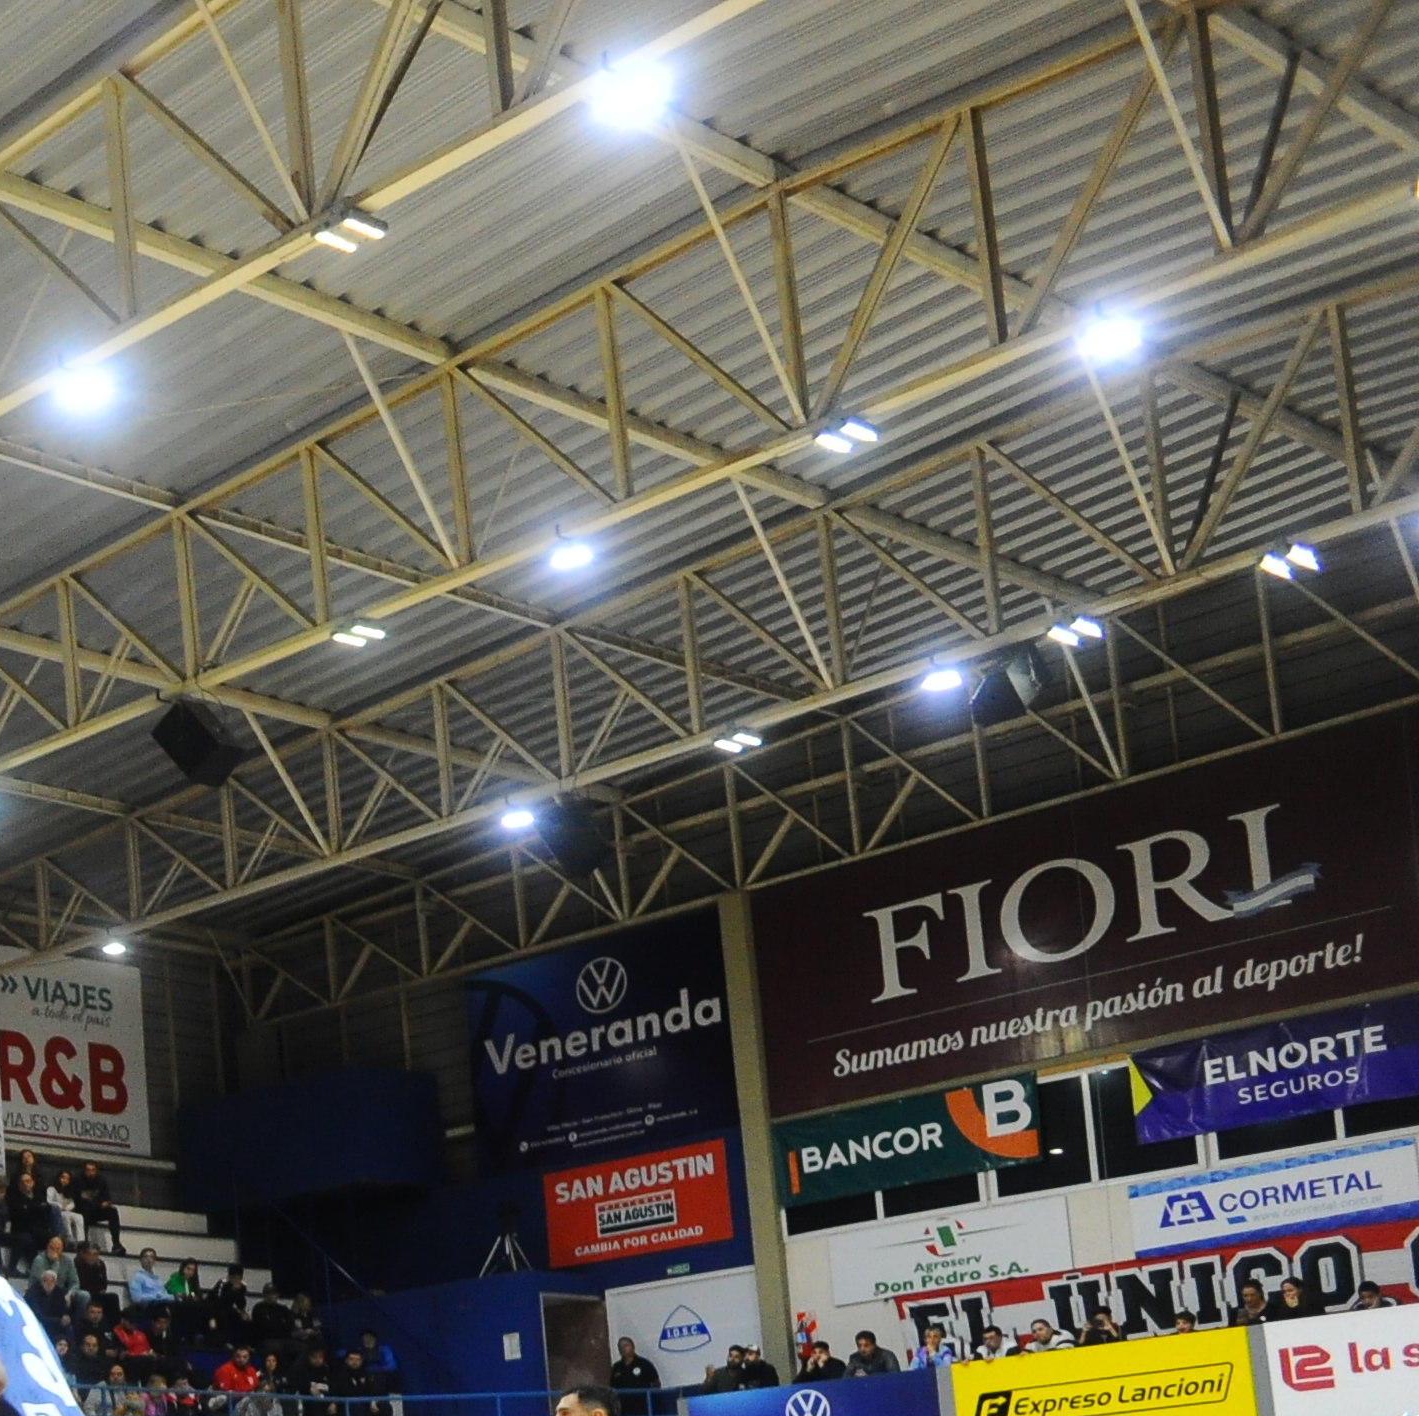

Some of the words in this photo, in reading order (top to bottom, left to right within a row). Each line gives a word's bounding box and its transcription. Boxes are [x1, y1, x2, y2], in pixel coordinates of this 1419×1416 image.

[862, 802, 1295, 1005] FIORI
[23, 975, 113, 1012] VIAJES
[832, 1028, 965, 1079] Sumamos
[969, 1003, 1081, 1048] nuestra
[1084, 974, 1185, 1031] pasión
[1191, 965, 1224, 998] al
[1232, 932, 1364, 993] deporte!
[484, 987, 723, 1076] Veneranda
[1236, 1065, 1361, 1107] SEGUROS
[2, 1111, 50, 1132] VIAJES
[52, 1117, 63, 1133] Y
[67, 1117, 131, 1142] TURISMO
[800, 1121, 944, 1175] BANCOR
[554, 1174, 604, 1204] SAN
[609, 1152, 715, 1194] AGUSTIN
[1218, 1168, 1384, 1214] CORMETAL
[598, 1211, 623, 1227] SAN
[624, 1201, 675, 1222] AGUSTIN
[574, 1241, 621, 1257] CAMBIA
[623, 1235, 649, 1248] POR
[650, 1225, 704, 1243] CALIDAD
[873, 1279, 916, 1296] Don
[919, 1270, 981, 1291] Pedro
[986, 1260, 1030, 1278] S.A.
[913, 1252, 982, 1275] Agroserv
[1347, 1341, 1391, 1375] la
[1117, 1373, 1226, 1404] Lancioni
